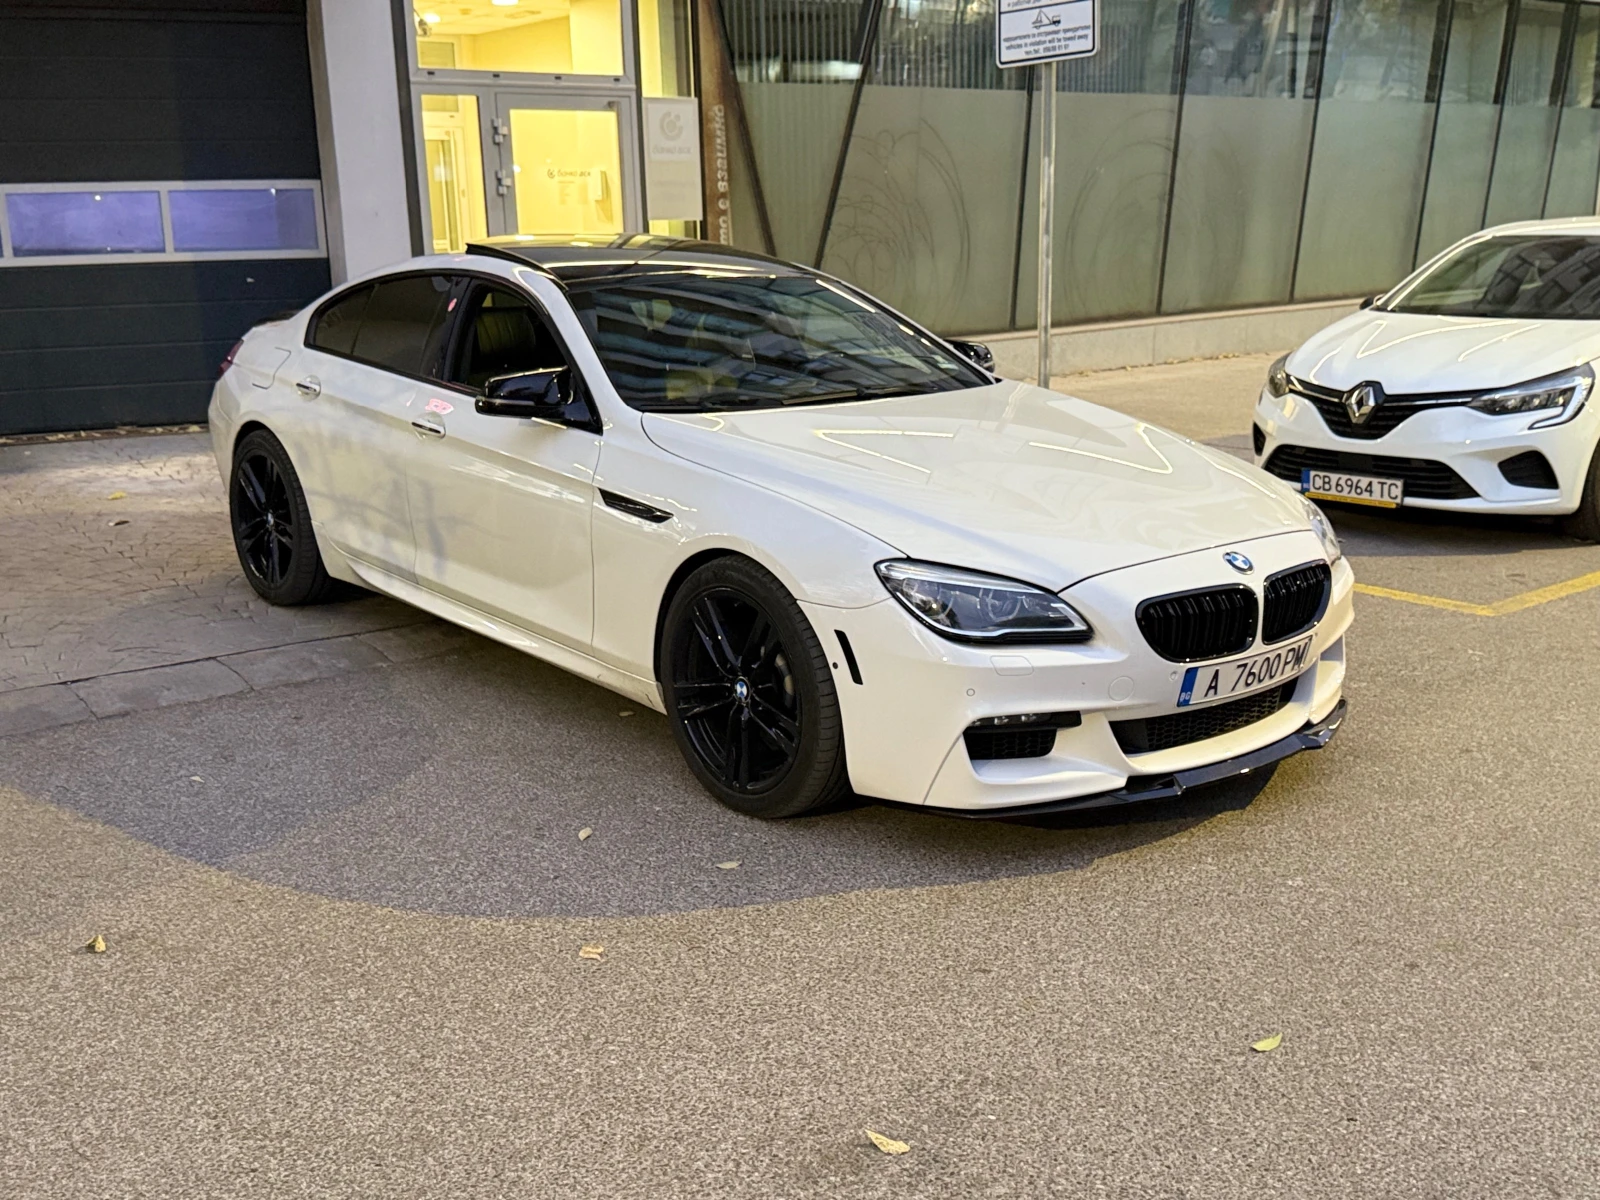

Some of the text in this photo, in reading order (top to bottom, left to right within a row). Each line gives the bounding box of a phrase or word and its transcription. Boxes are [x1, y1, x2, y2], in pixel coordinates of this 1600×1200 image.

[1312, 474, 1399, 500] CB 6964 TC
[1204, 641, 1309, 697] A 7600 PM
[1179, 691, 1191, 700] BG
